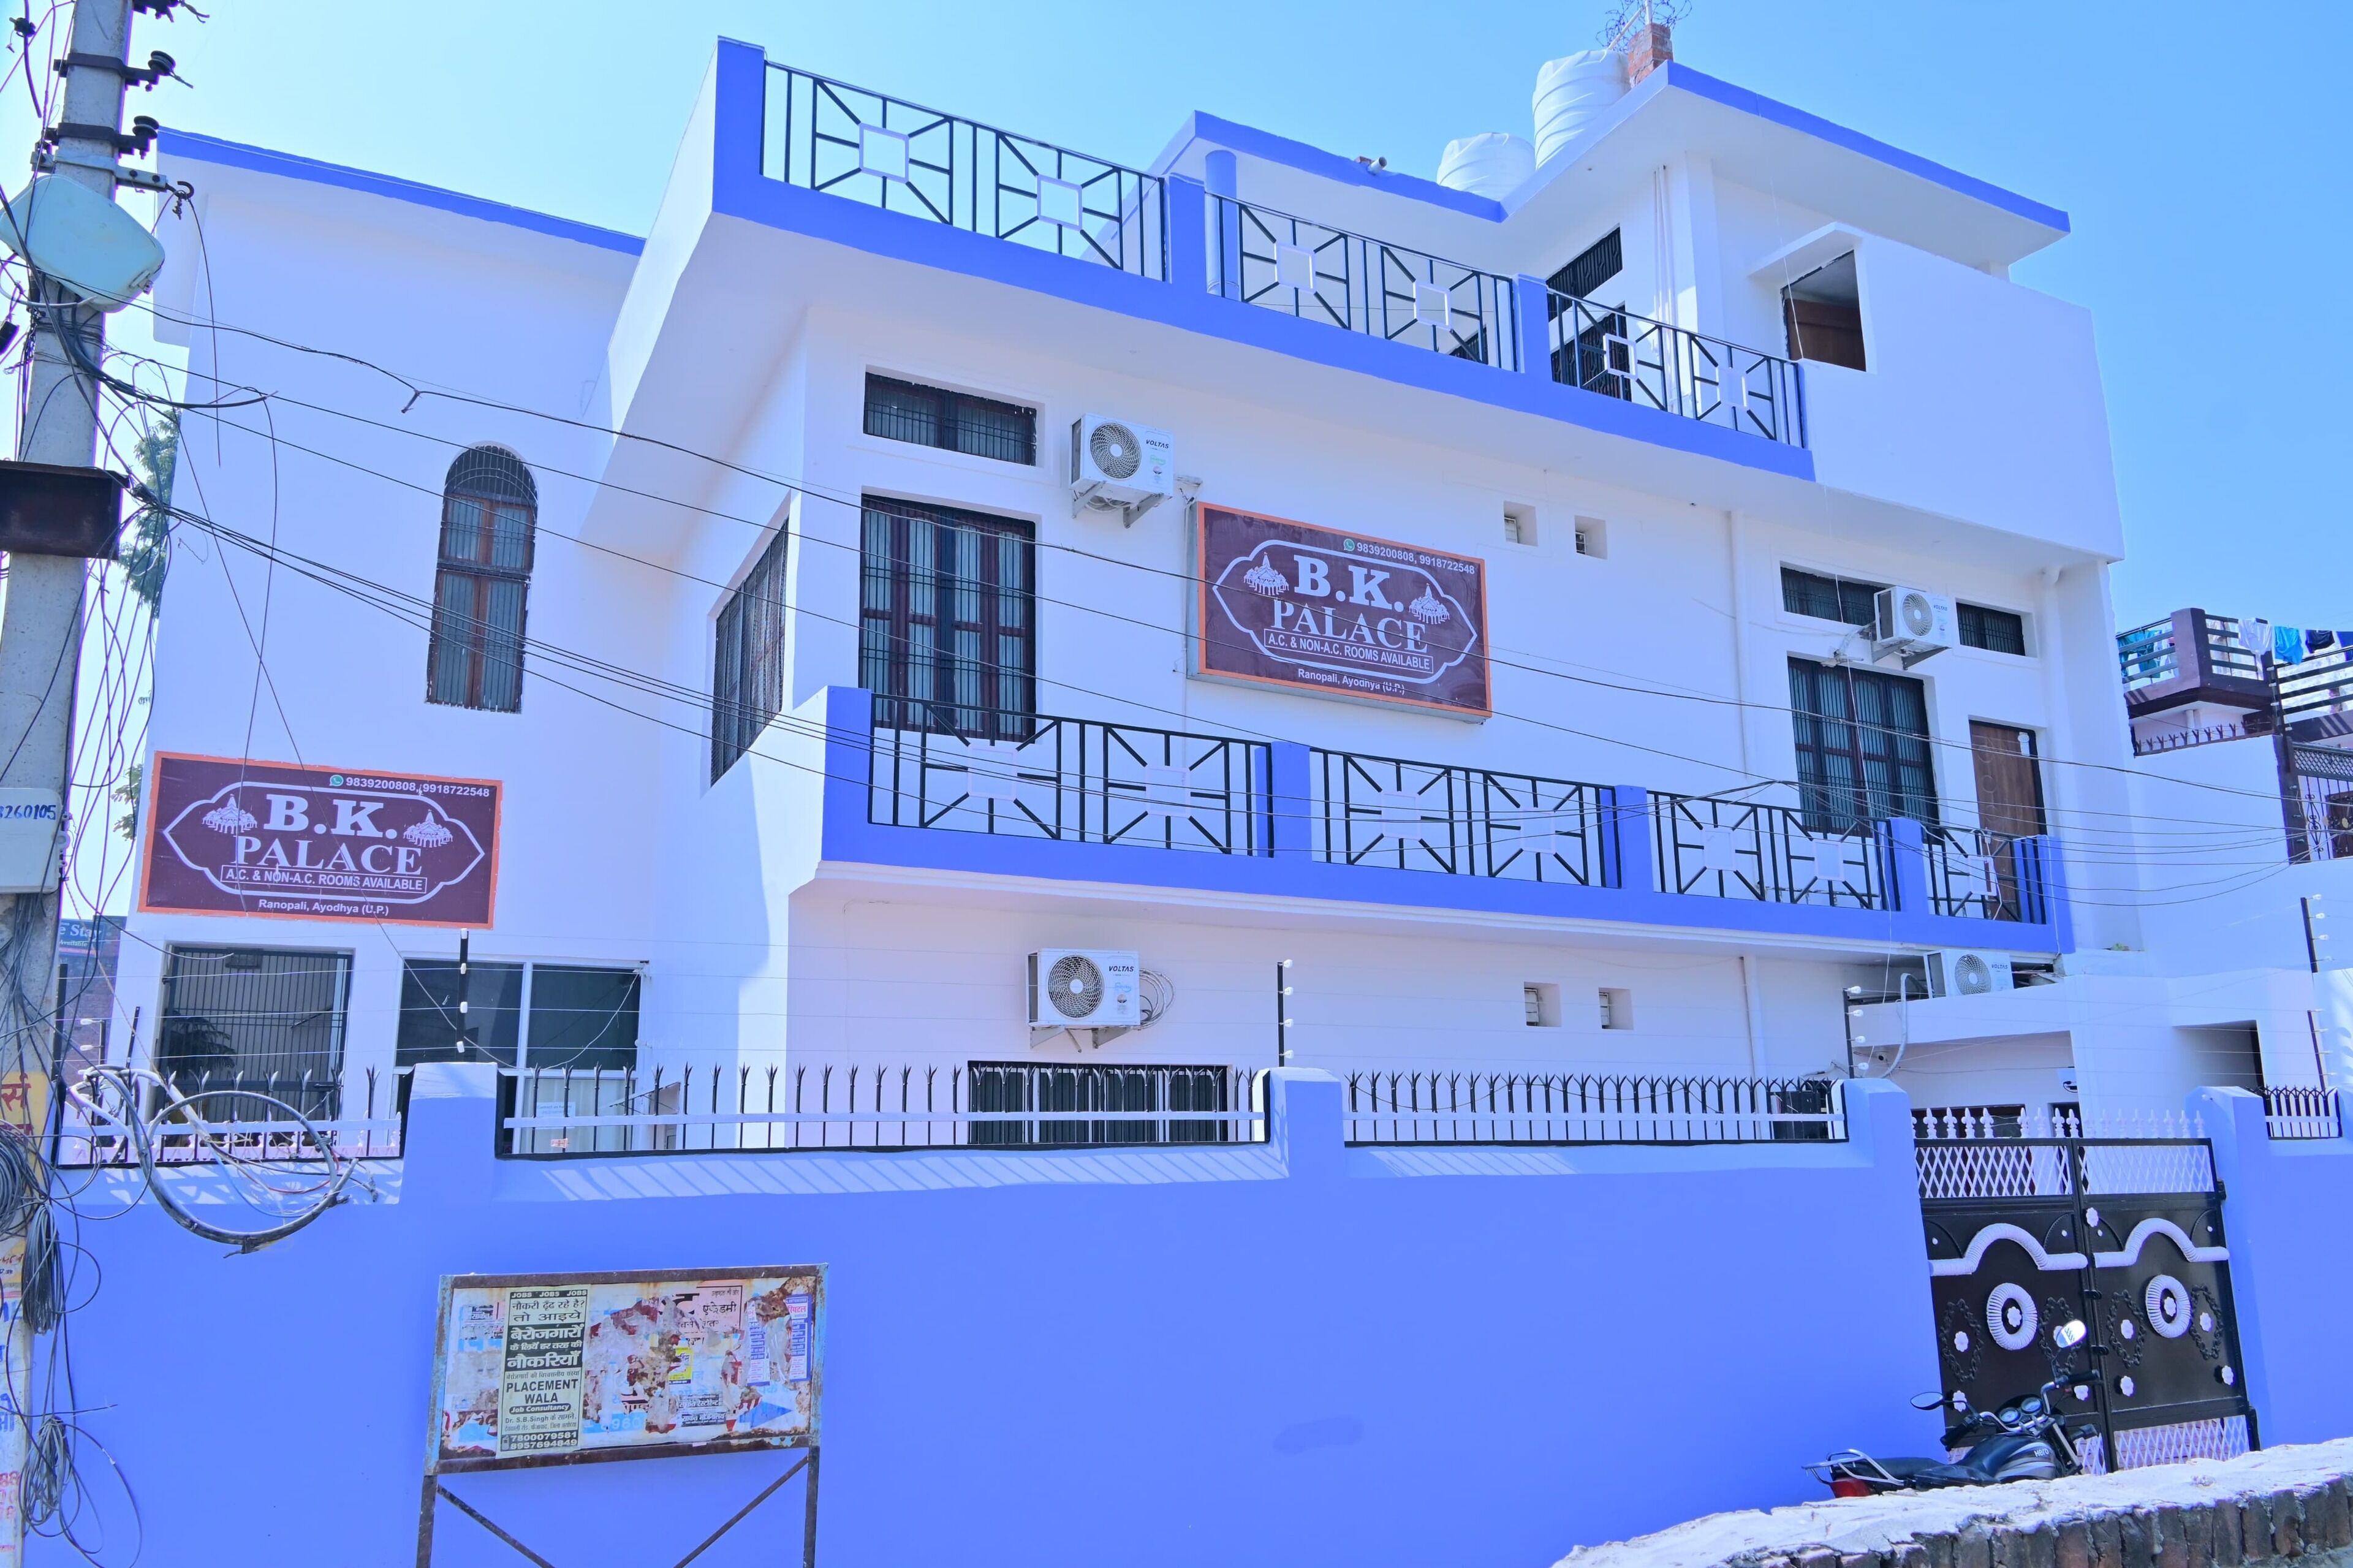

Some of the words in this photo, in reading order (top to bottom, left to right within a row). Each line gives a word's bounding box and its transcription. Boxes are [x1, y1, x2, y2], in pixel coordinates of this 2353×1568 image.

[1146, 439, 1169, 449] VOLTAS
[1357, 542, 1417, 564] 9839200808,
[1420, 555, 1475, 574] 9918722548
[1294, 555, 1404, 613] B.K.
[1271, 597, 1428, 653] PALACE
[1268, 633, 1287, 647] A.C.
[1290, 637, 1297, 648] &
[1300, 638, 1342, 656] NON-A.C.
[1344, 646, 1378, 661] ROOMS
[1381, 653, 1430, 670] AVAILABLE
[1298, 668, 1340, 684] Ranopali,
[1342, 675, 1380, 691] Ayodhya
[1382, 681, 1405, 695] (U.P.)
[346, 777, 419, 793] 9839200808,
[423, 783, 490, 797] 9918722548
[263, 794, 397, 839] B.K.
[230, 836, 422, 875] PALACE
[226, 869, 249, 880] A.C.
[252, 870, 261, 881] &
[264, 871, 315, 884] NON-A.C.
[319, 874, 360, 887] ROOMS
[362, 876, 422, 890] AVAILABLE
[259, 899, 309, 911] Ranopali,
[312, 902, 359, 914] Ayodhya
[362, 904, 389, 915] (U.P.)
[513, 1311, 531, 1322] तो
[538, 1309, 582, 1322] आइये
[570, 1339, 582, 1348] की
[506, 1379, 578, 1393] PLACEMENT
[525, 1392, 559, 1404] WALA
[526, 1404, 570, 1412] Consultancy
[510, 1431, 577, 1441] 7800079581
[510, 1439, 577, 1449] 8957694849
